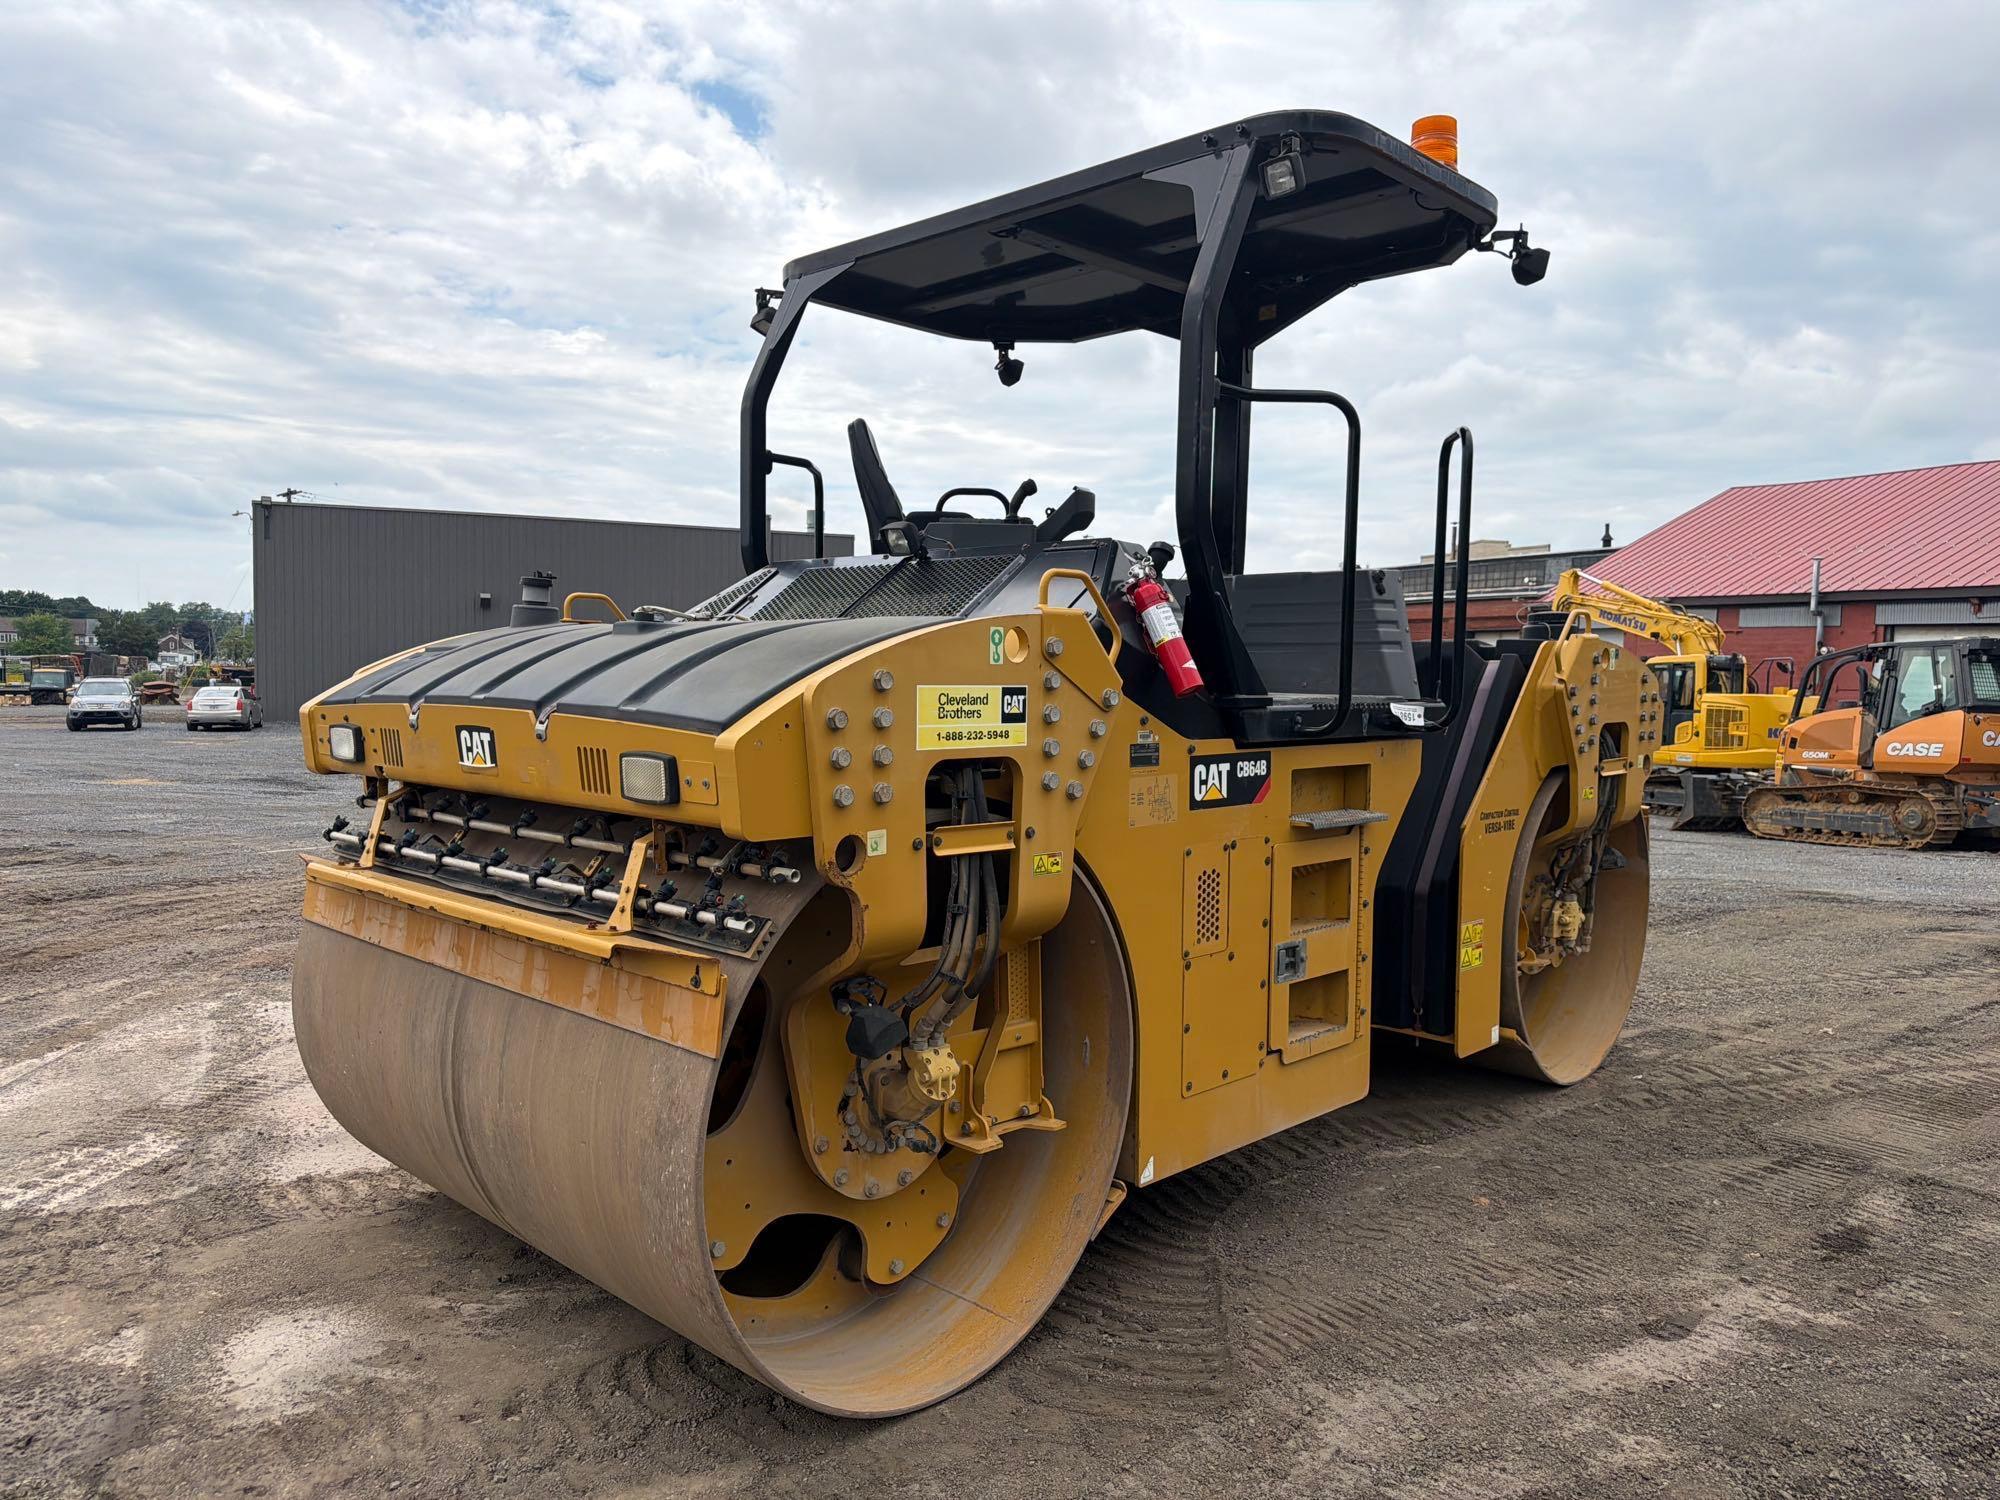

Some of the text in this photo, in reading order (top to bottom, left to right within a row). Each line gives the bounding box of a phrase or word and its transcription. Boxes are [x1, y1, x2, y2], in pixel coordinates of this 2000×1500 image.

[1598, 609, 1647, 631] KOMATSU
[938, 693, 988, 706] Cleveland
[1003, 694, 1025, 714] CAT
[938, 706, 981, 719] Brothers
[936, 730, 1010, 741] 1-888-232-5948
[460, 729, 492, 766] CAT
[1802, 751, 1829, 759] 650M
[1886, 742, 1944, 757] CASE
[1194, 760, 1267, 801] CAT CB64B
[1485, 819, 1516, 834] VERSA-VIBE
